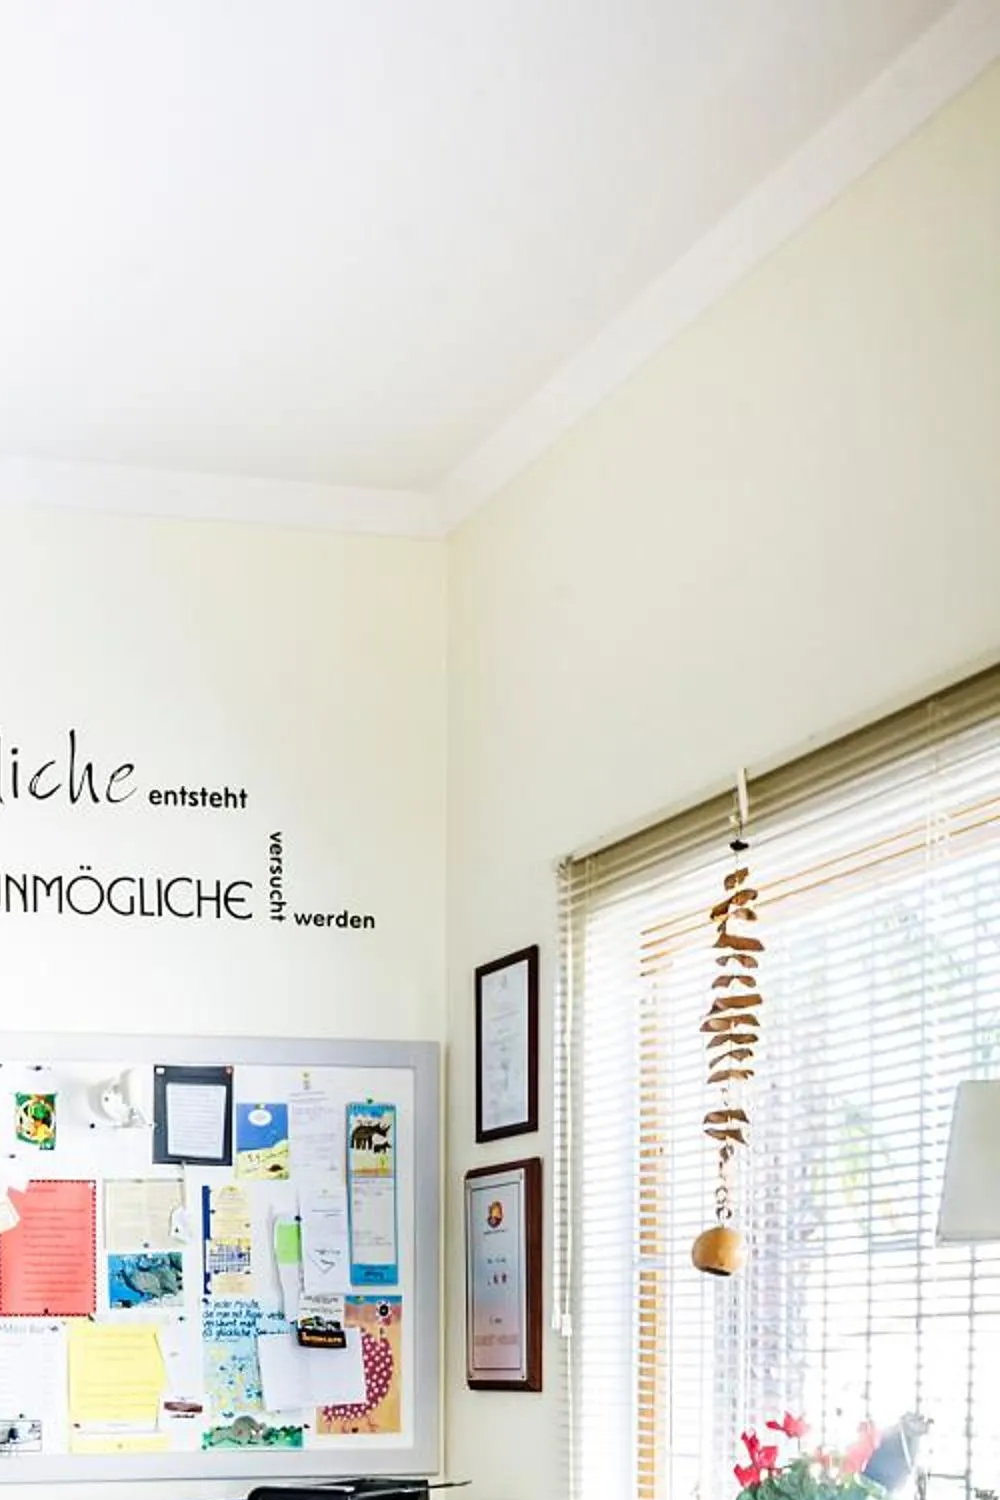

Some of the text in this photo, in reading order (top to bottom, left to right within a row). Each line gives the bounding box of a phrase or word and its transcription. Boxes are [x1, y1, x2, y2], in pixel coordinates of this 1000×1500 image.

[148, 785, 248, 810] entsteht
[268, 831, 287, 922] versucht
[293, 908, 376, 929] werden
